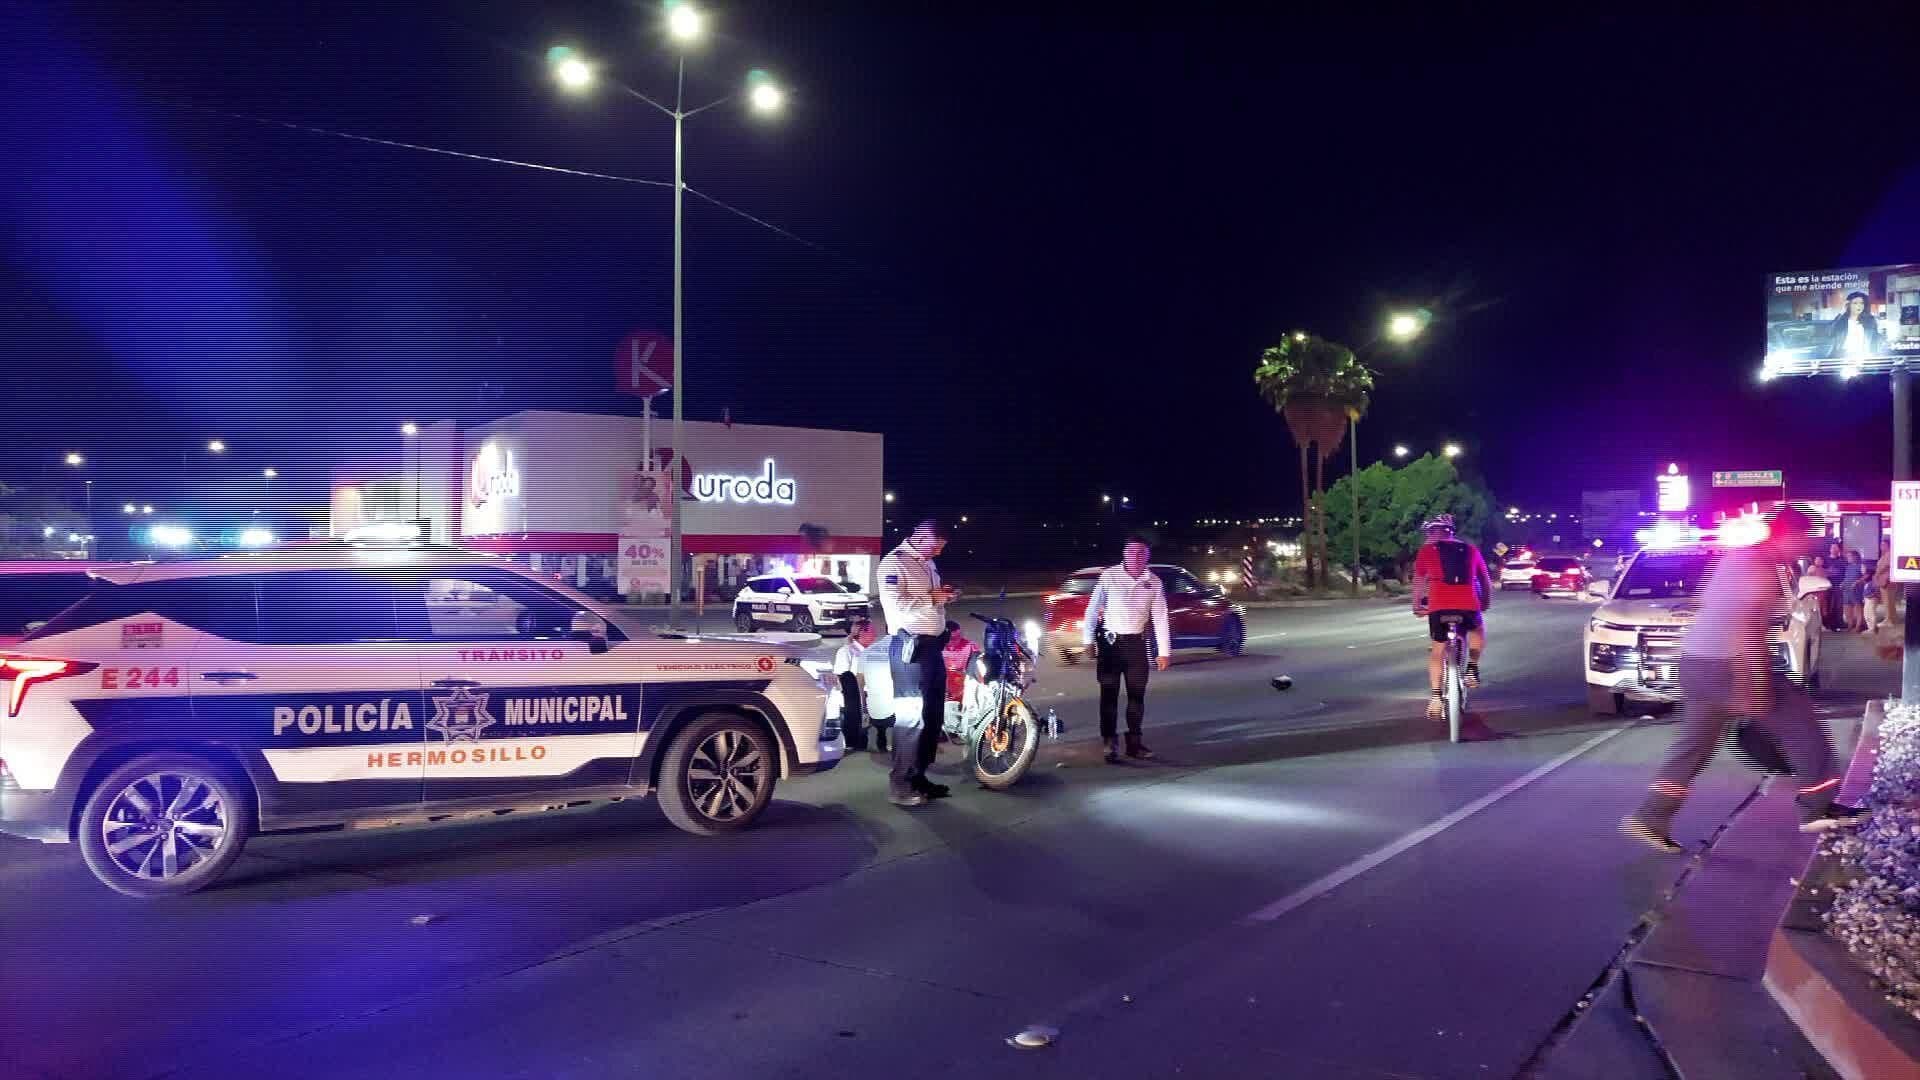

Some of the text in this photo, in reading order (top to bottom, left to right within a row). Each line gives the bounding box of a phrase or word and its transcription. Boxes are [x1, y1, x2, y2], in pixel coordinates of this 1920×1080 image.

[1775, 272, 1859, 285] Esta es la estación
[1775, 285, 1792, 294] que
[1809, 282, 1842, 291] atiende
[1844, 280, 1870, 290] mejor
[631, 338, 673, 389] K
[623, 543, 665, 560] 40%
[101, 667, 179, 689] E 244
[273, 698, 414, 736] POLICÍA
[504, 694, 628, 726] MUNICIPAL
[367, 745, 547, 768] HERMOSILLO
